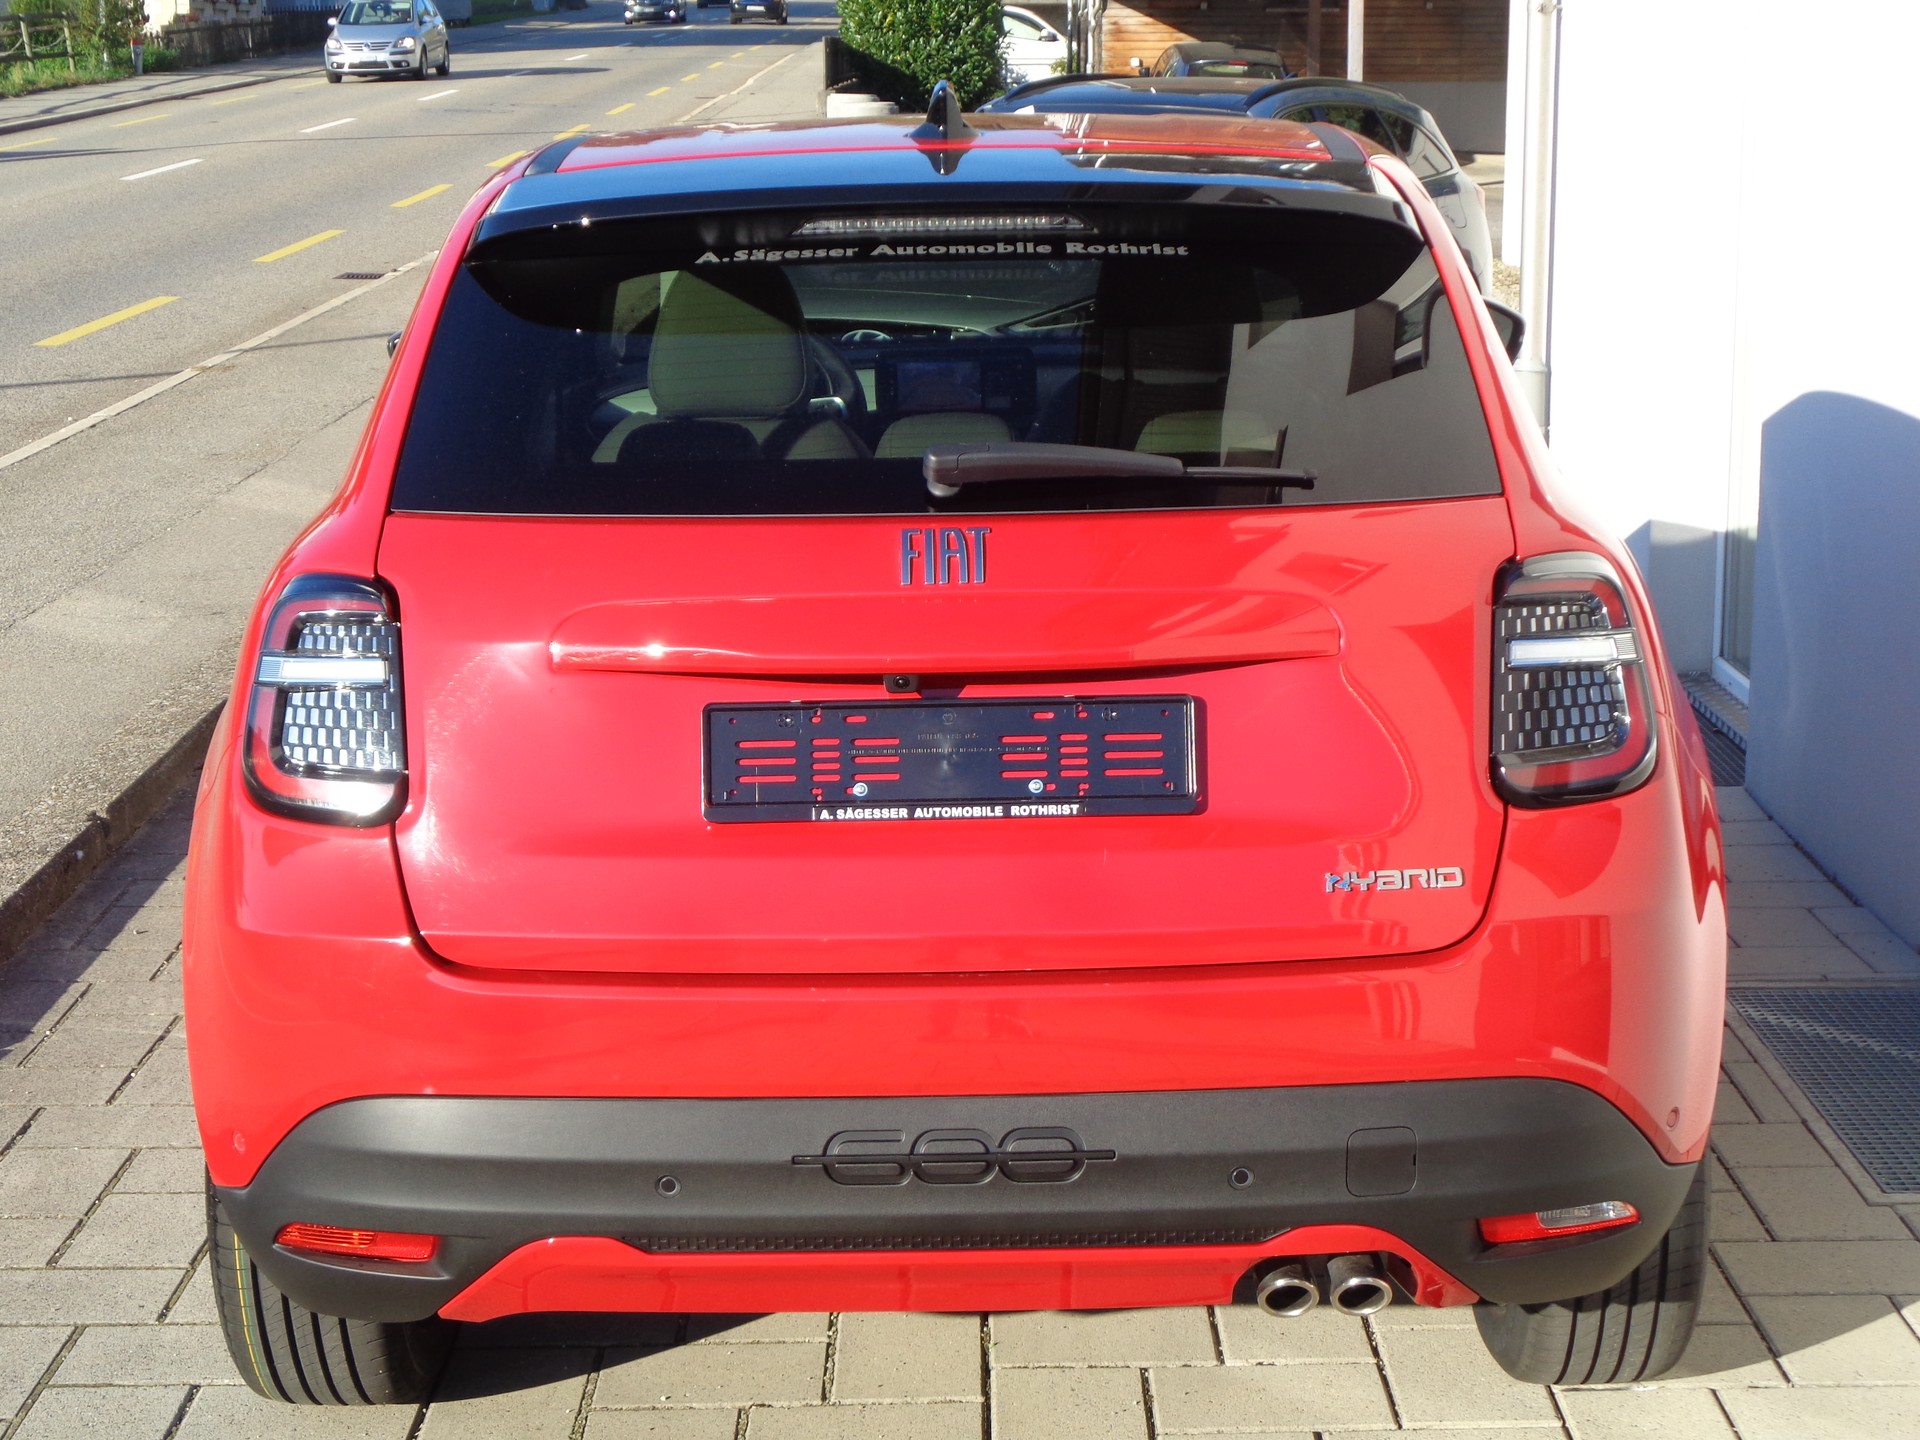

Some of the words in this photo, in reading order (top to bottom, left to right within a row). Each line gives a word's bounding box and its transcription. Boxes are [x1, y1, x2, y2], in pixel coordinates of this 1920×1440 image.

[870, 242, 1052, 257] Automobile
[1065, 242, 1190, 256] Rothrist
[901, 527, 991, 586] FIAT
[836, 806, 908, 820] SÄGESSER
[914, 805, 1004, 818] AUTOMOBILE
[1010, 804, 1080, 817] ROTHRIST
[1324, 866, 1464, 893] HYBRID
[822, 1126, 1087, 1186] 600
